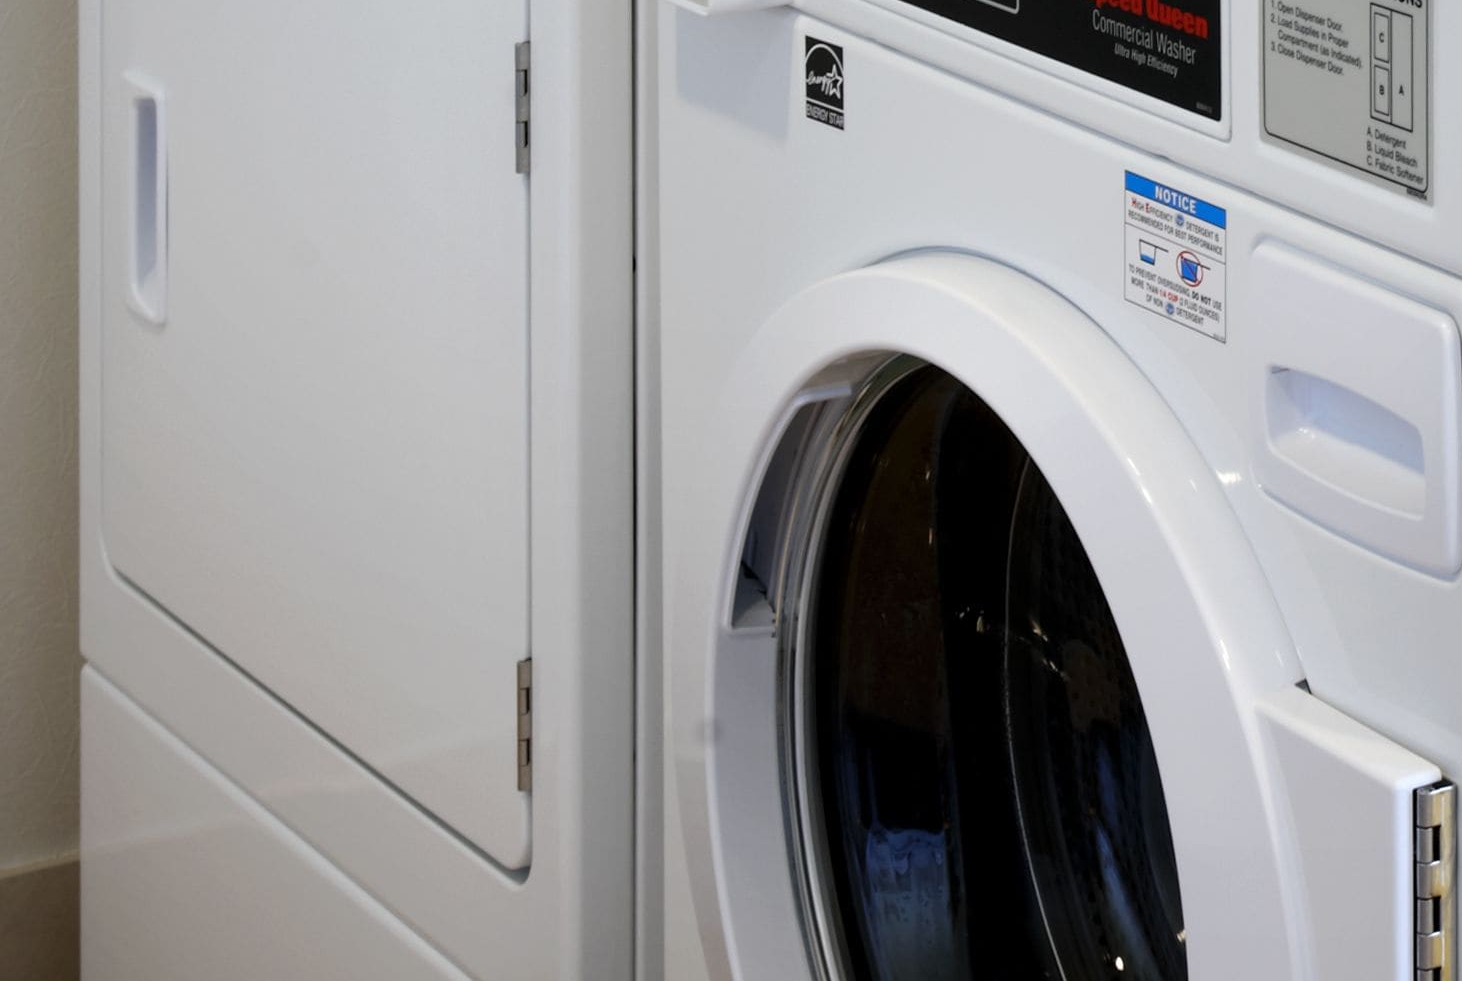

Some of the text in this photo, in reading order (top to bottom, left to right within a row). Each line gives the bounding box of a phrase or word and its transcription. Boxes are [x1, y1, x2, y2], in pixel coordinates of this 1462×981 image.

[1277, 0, 1294, 18] Open
[1295, 5, 1325, 28] Dispenser
[1278, 14, 1293, 31] Load
[1092, 8, 1196, 66] Commercial Washer
[1378, 32, 1385, 43] C
[1114, 42, 1178, 78] Ultra High Efficiency
[1278, 43, 1294, 59] Close
[1296, 49, 1326, 73] Dispenser
[1398, 84, 1404, 96] A
[806, 103, 829, 123] ENERGY
[1154, 184, 1197, 215] NOTICE
[1164, 223, 1174, 236] FOR
[1168, 290, 1179, 305] CUP
[1191, 288, 1199, 301] DO
[1200, 291, 1211, 306] NOT
